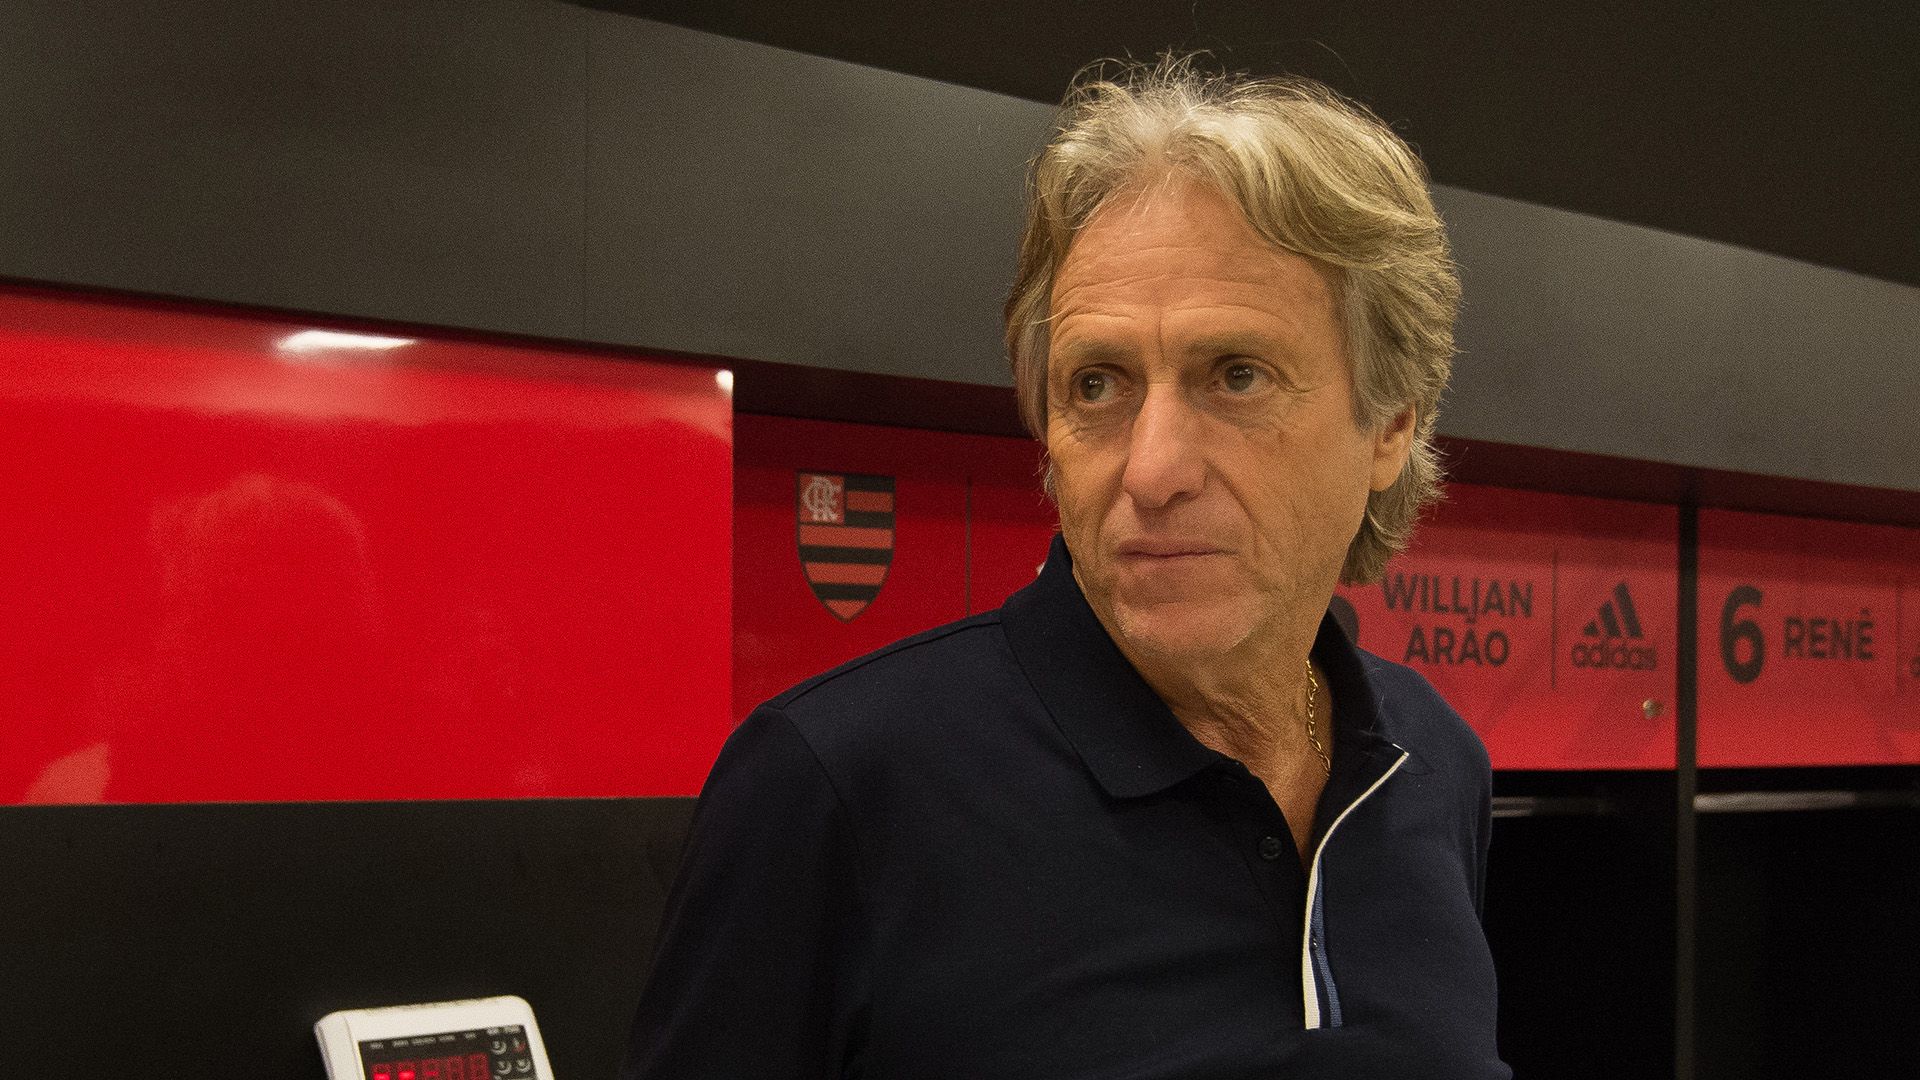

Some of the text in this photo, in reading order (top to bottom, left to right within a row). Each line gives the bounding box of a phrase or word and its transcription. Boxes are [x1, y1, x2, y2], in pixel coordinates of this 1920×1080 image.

[1570, 636, 1657, 671] adidas
[1720, 584, 1766, 684] 6
[1783, 607, 1876, 661] RENÊ
